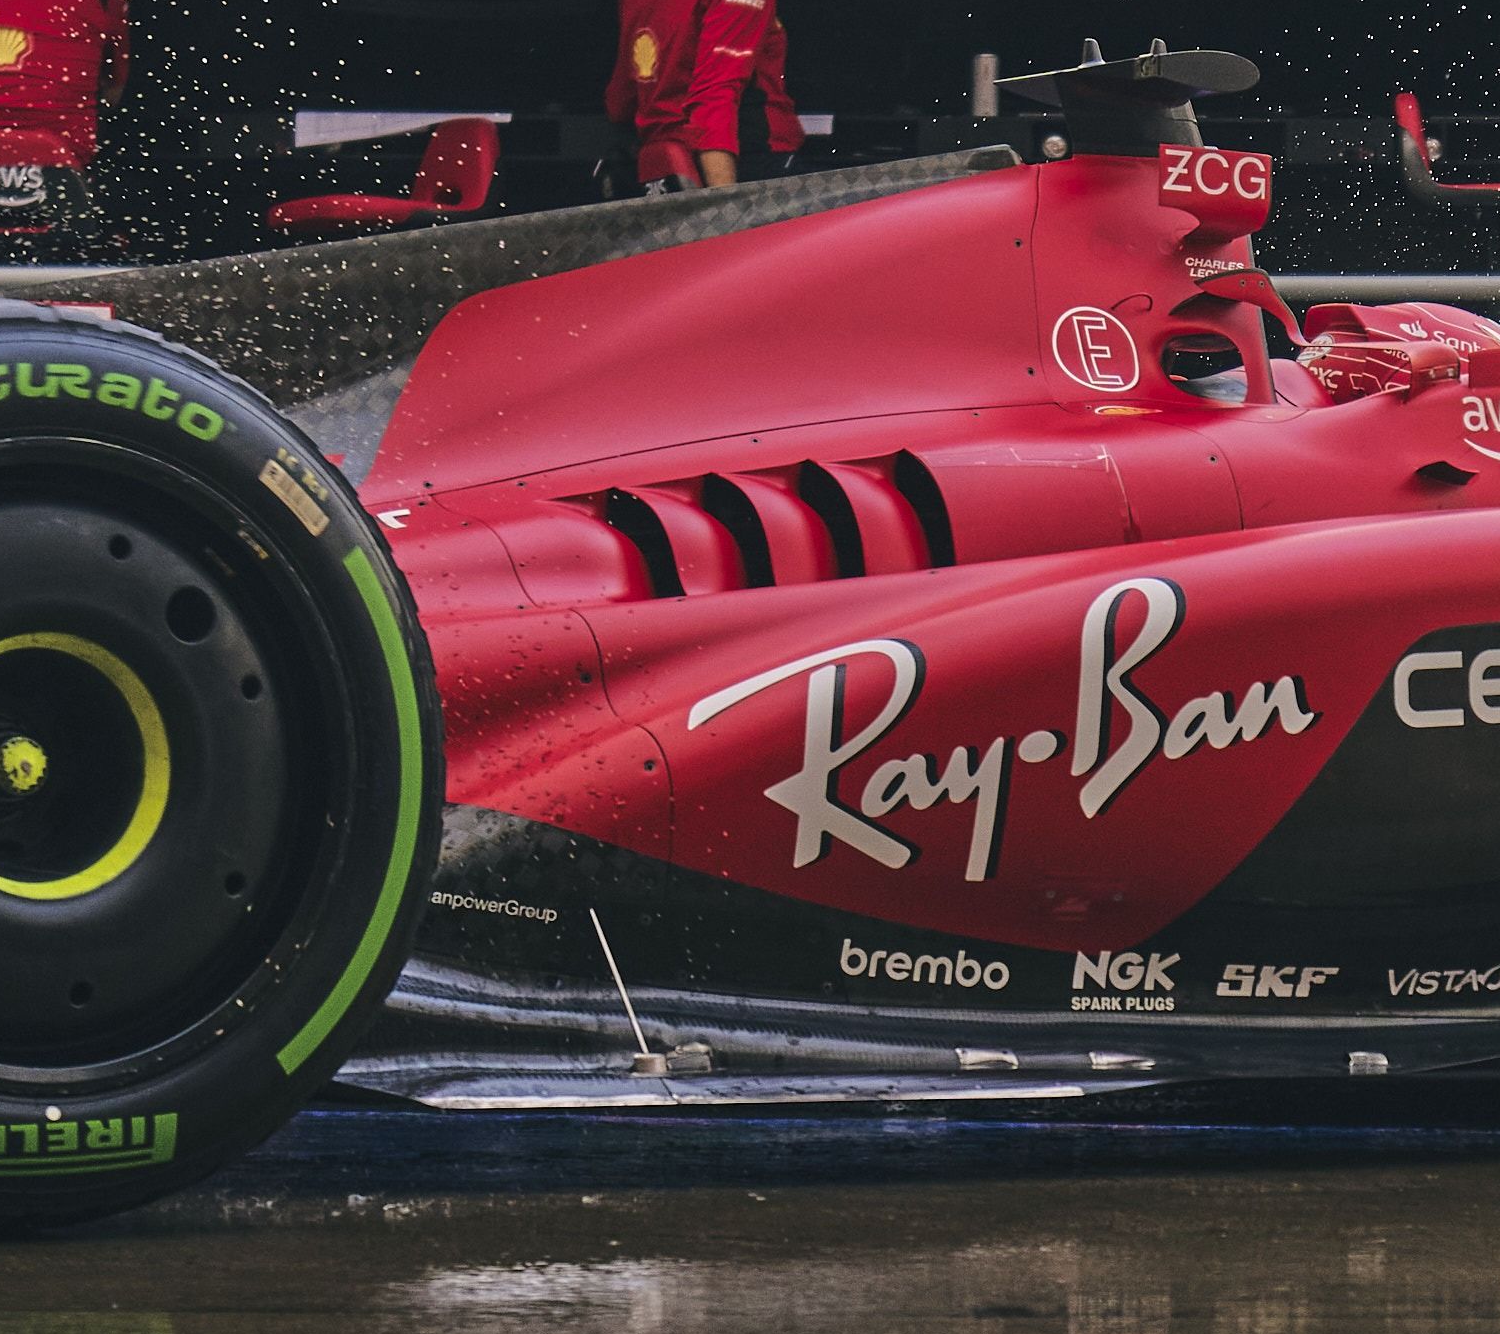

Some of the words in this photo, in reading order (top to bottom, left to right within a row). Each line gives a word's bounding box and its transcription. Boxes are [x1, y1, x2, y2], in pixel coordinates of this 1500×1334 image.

[1185, 257, 1244, 270] CHARLES
[428, 891, 558, 924] anpowerGroup
[840, 938, 1010, 990] brembo
[1071, 950, 1181, 992] NGK
[1216, 964, 1339, 998] SKF
[1071, 996, 1121, 1012] SPARK
[1125, 996, 1175, 1012] PLUGS
